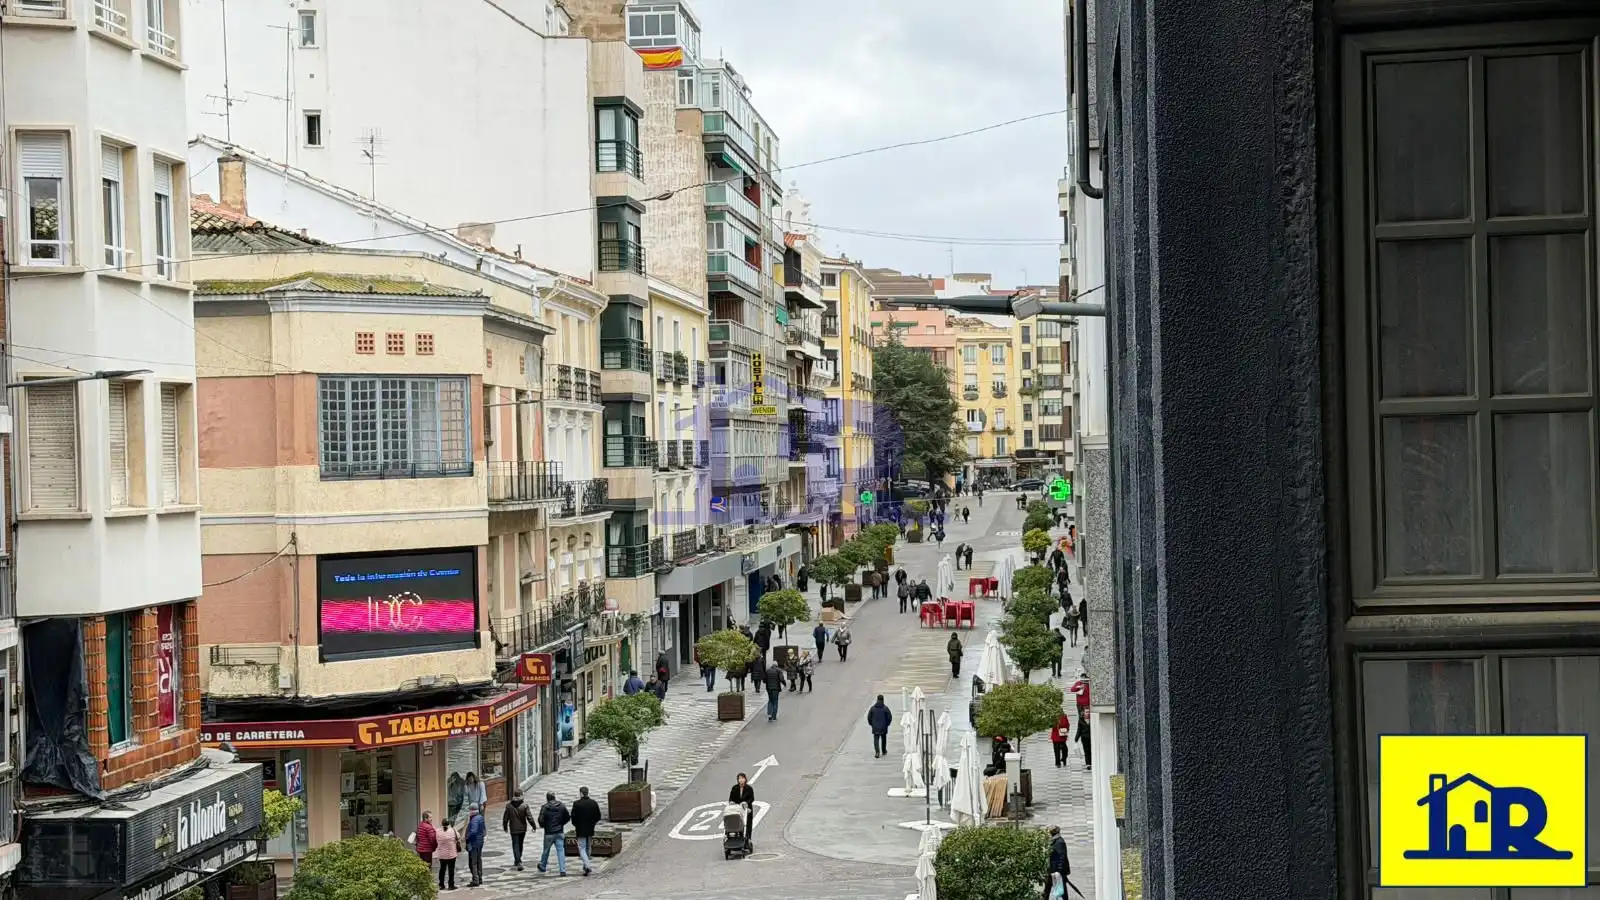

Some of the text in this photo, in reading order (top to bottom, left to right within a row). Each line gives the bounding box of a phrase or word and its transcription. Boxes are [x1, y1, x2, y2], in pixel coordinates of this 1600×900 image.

[753, 353, 762, 394] HOSTAL
[216, 731, 231, 741] DE
[236, 730, 304, 740] CARRETERIA
[389, 709, 479, 736] TABACOS
[177, 806, 188, 853] la
[190, 791, 226, 847] blonda
